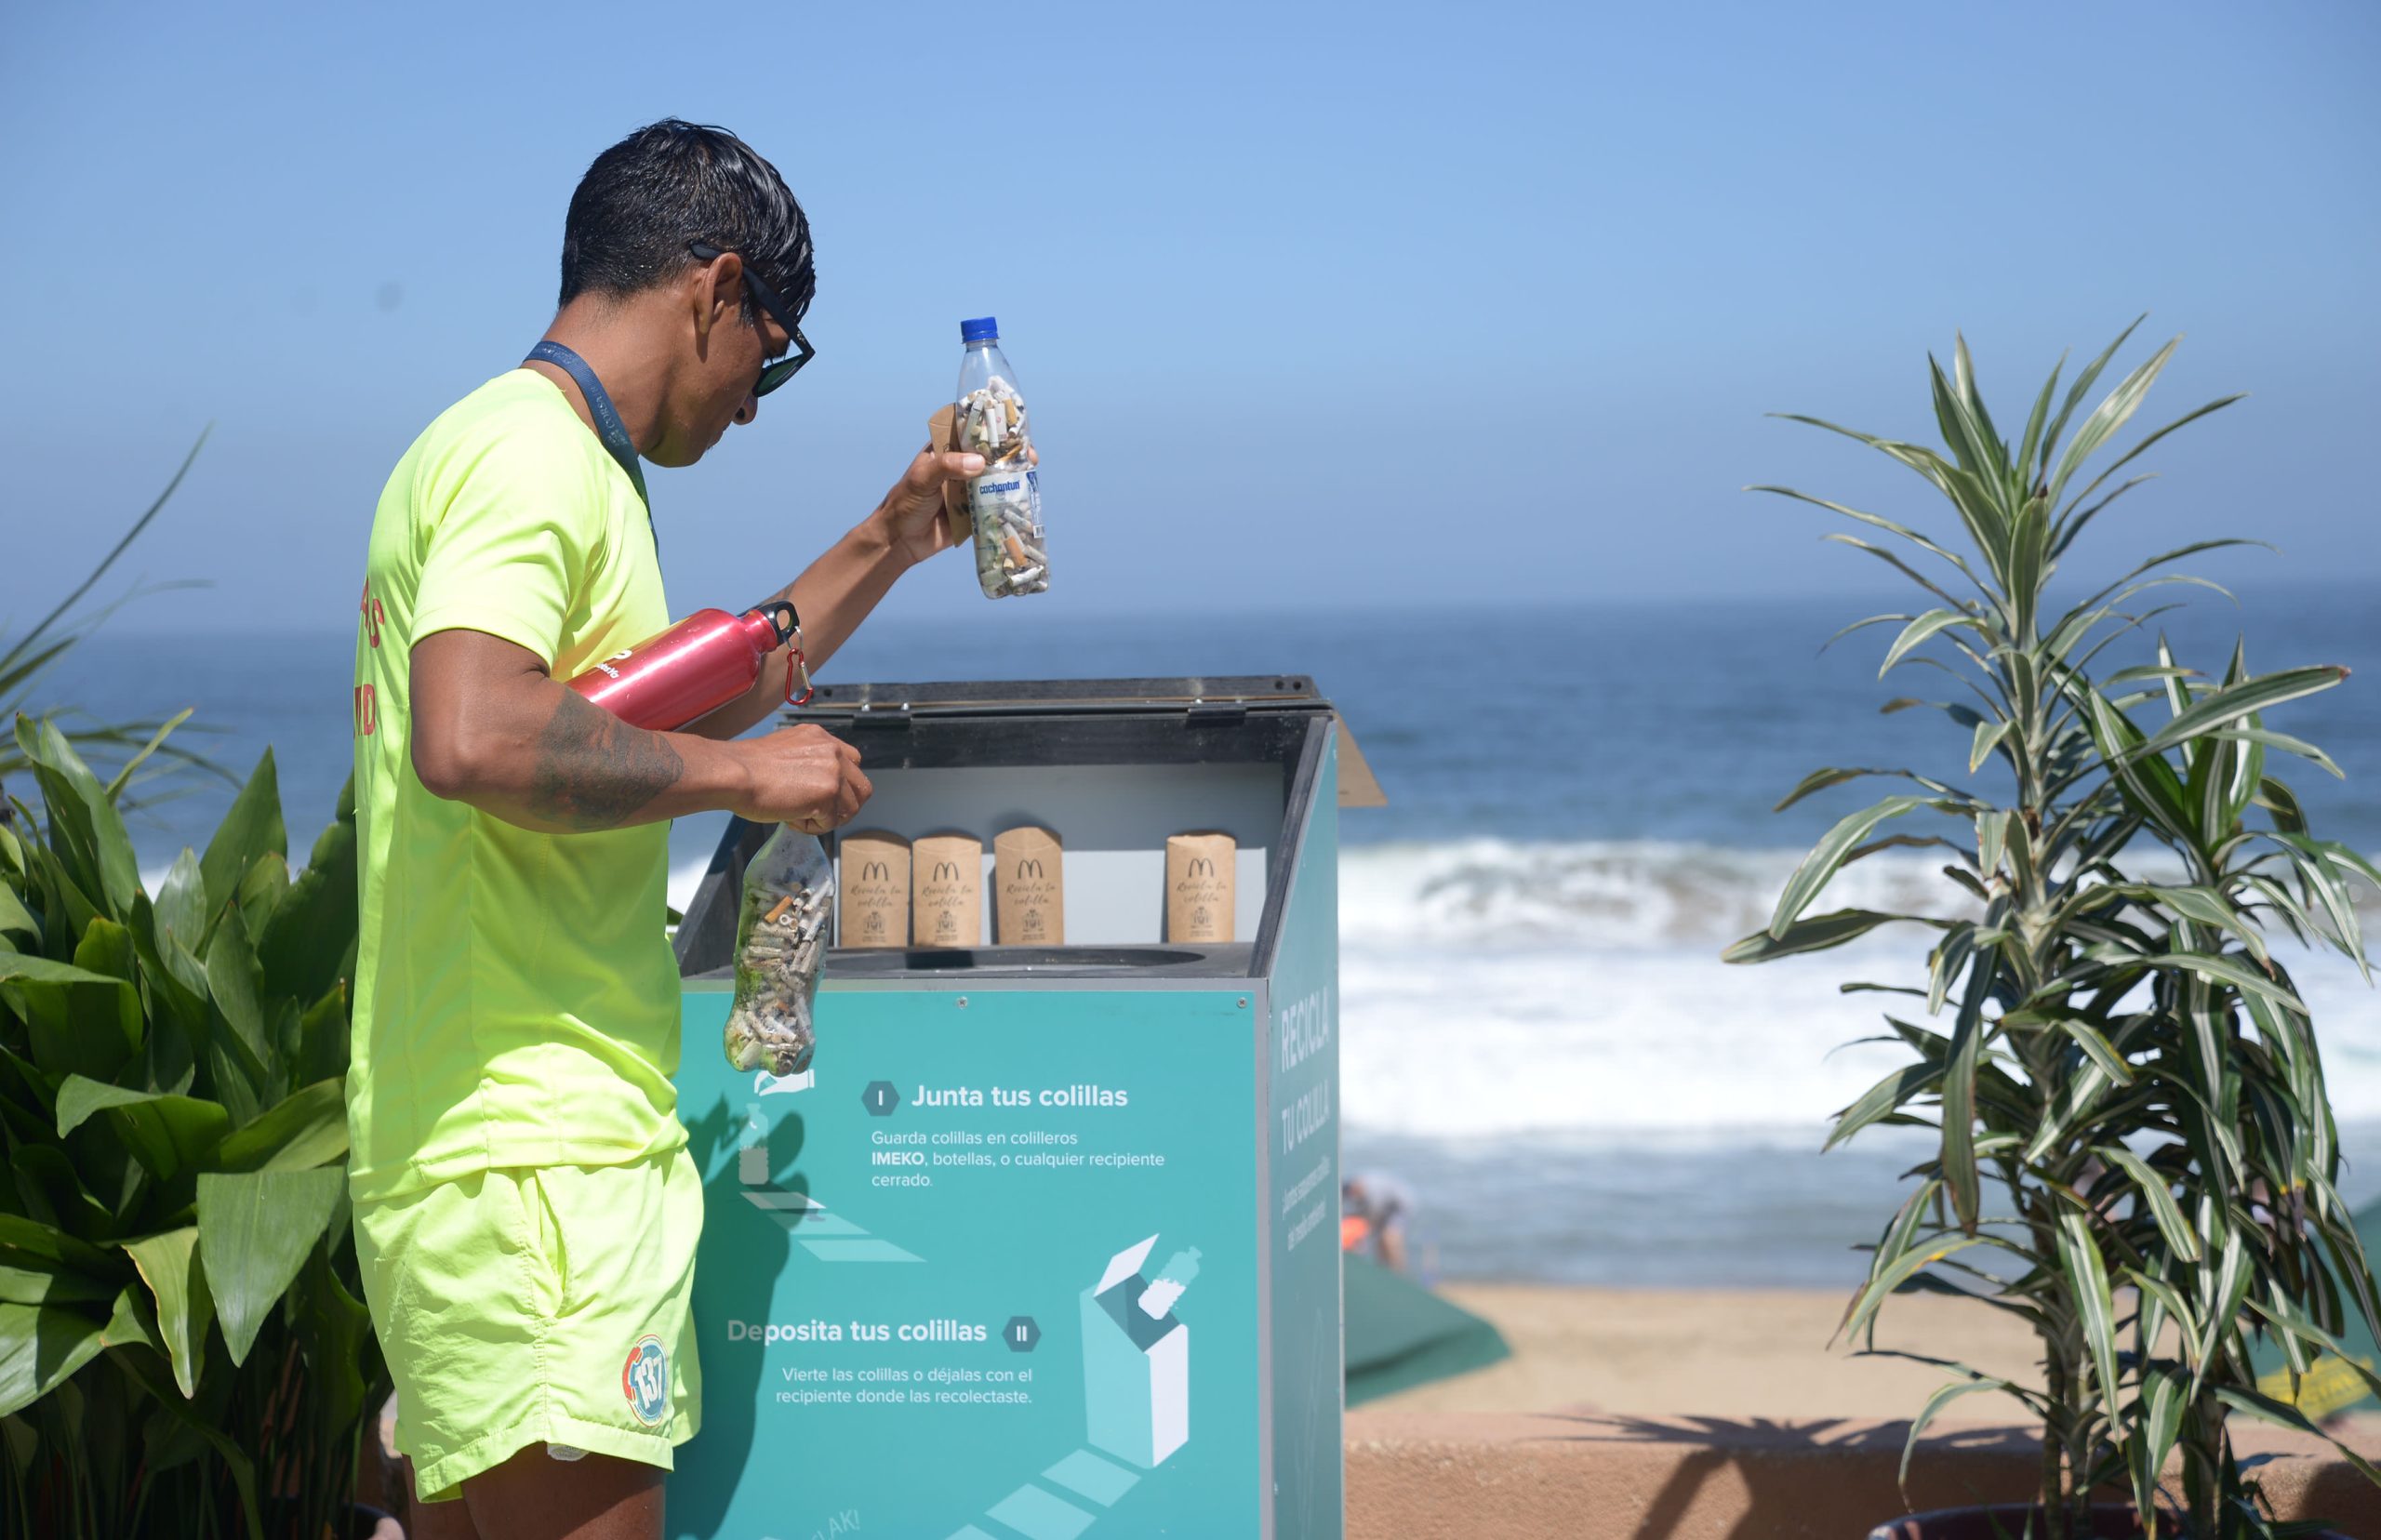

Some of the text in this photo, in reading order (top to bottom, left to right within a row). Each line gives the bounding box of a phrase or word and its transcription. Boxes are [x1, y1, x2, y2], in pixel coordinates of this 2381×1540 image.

[361, 575, 385, 648] AS
[1282, 986, 1329, 1073] RECICLA
[911, 1083, 1129, 1108] Junta tus colillas
[1282, 1079, 1329, 1156] TU COLILLA
[871, 1130, 1078, 1145] Guarda colillas en colilleros
[871, 1151, 1164, 1169] IMEKO, botellas, o cualquier recipiente
[871, 1173, 933, 1188] cerrado.
[727, 1318, 988, 1347] Deposita tus colillas
[634, 1353, 663, 1410] 137
[782, 1367, 1032, 1385] Vierte las colillas o déjalas con el
[776, 1389, 1031, 1405] recipiente donde las recolectaste.
